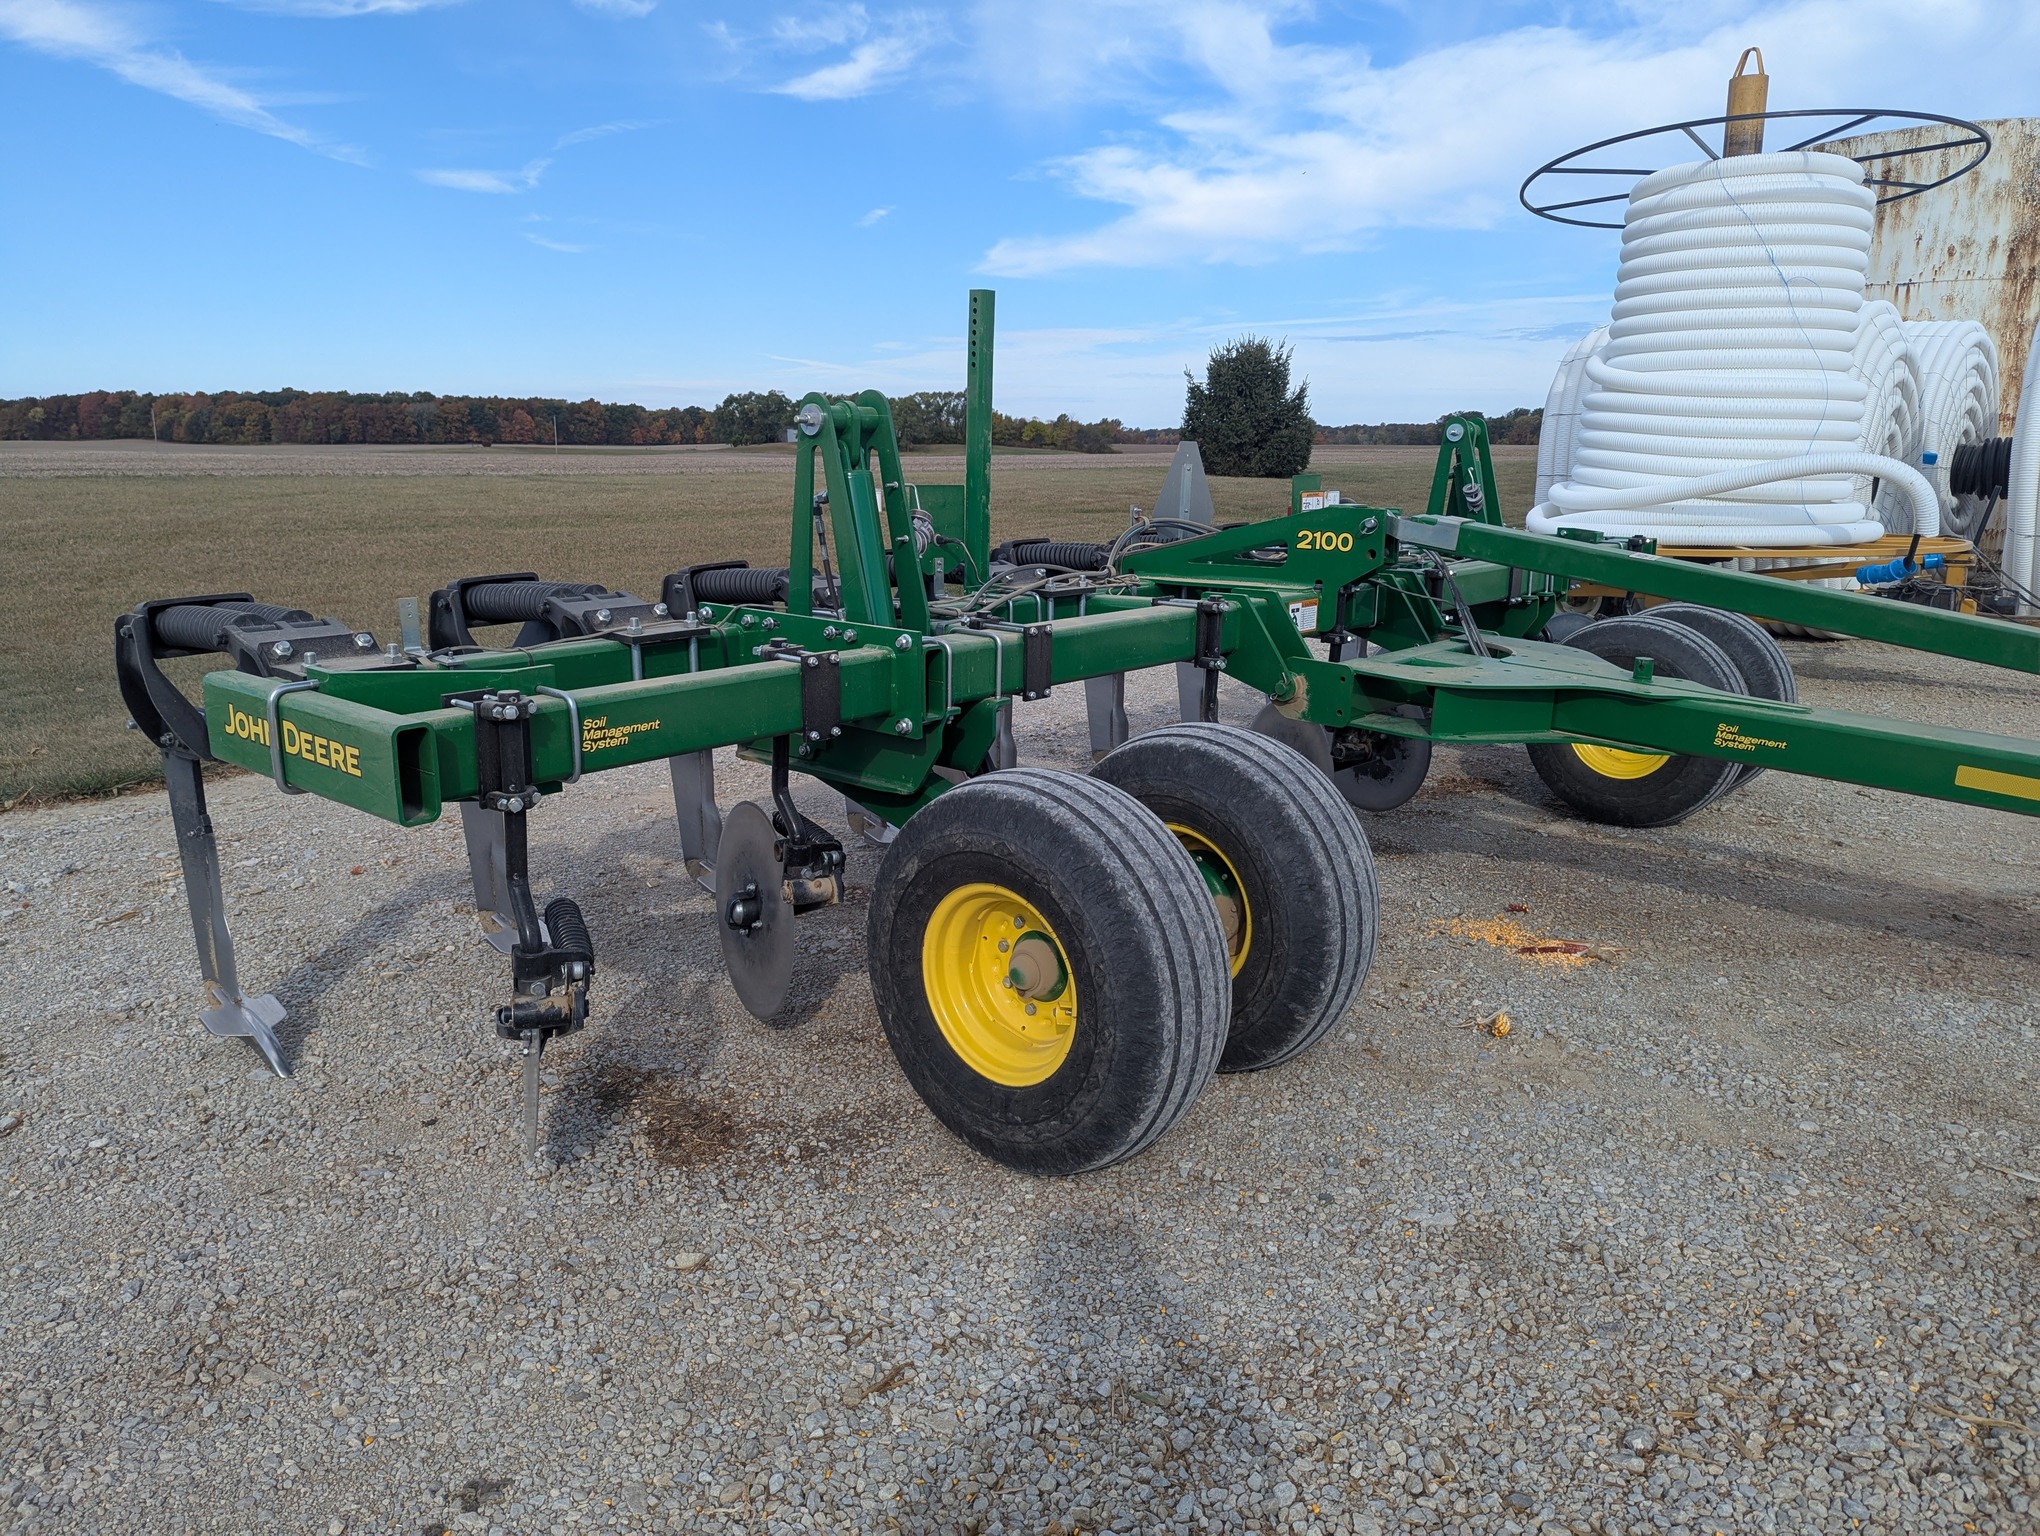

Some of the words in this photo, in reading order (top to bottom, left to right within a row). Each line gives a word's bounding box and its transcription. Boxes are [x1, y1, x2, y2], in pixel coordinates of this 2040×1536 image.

[1296, 530, 1354, 552] 2100
[582, 716, 607, 730] Soil
[582, 719, 660, 741] Management
[1717, 723, 1740, 733] Soil
[282, 719, 363, 778] DEERE
[581, 736, 629, 752] System
[1713, 737, 1756, 752] System
[1715, 731, 1788, 750] Management
